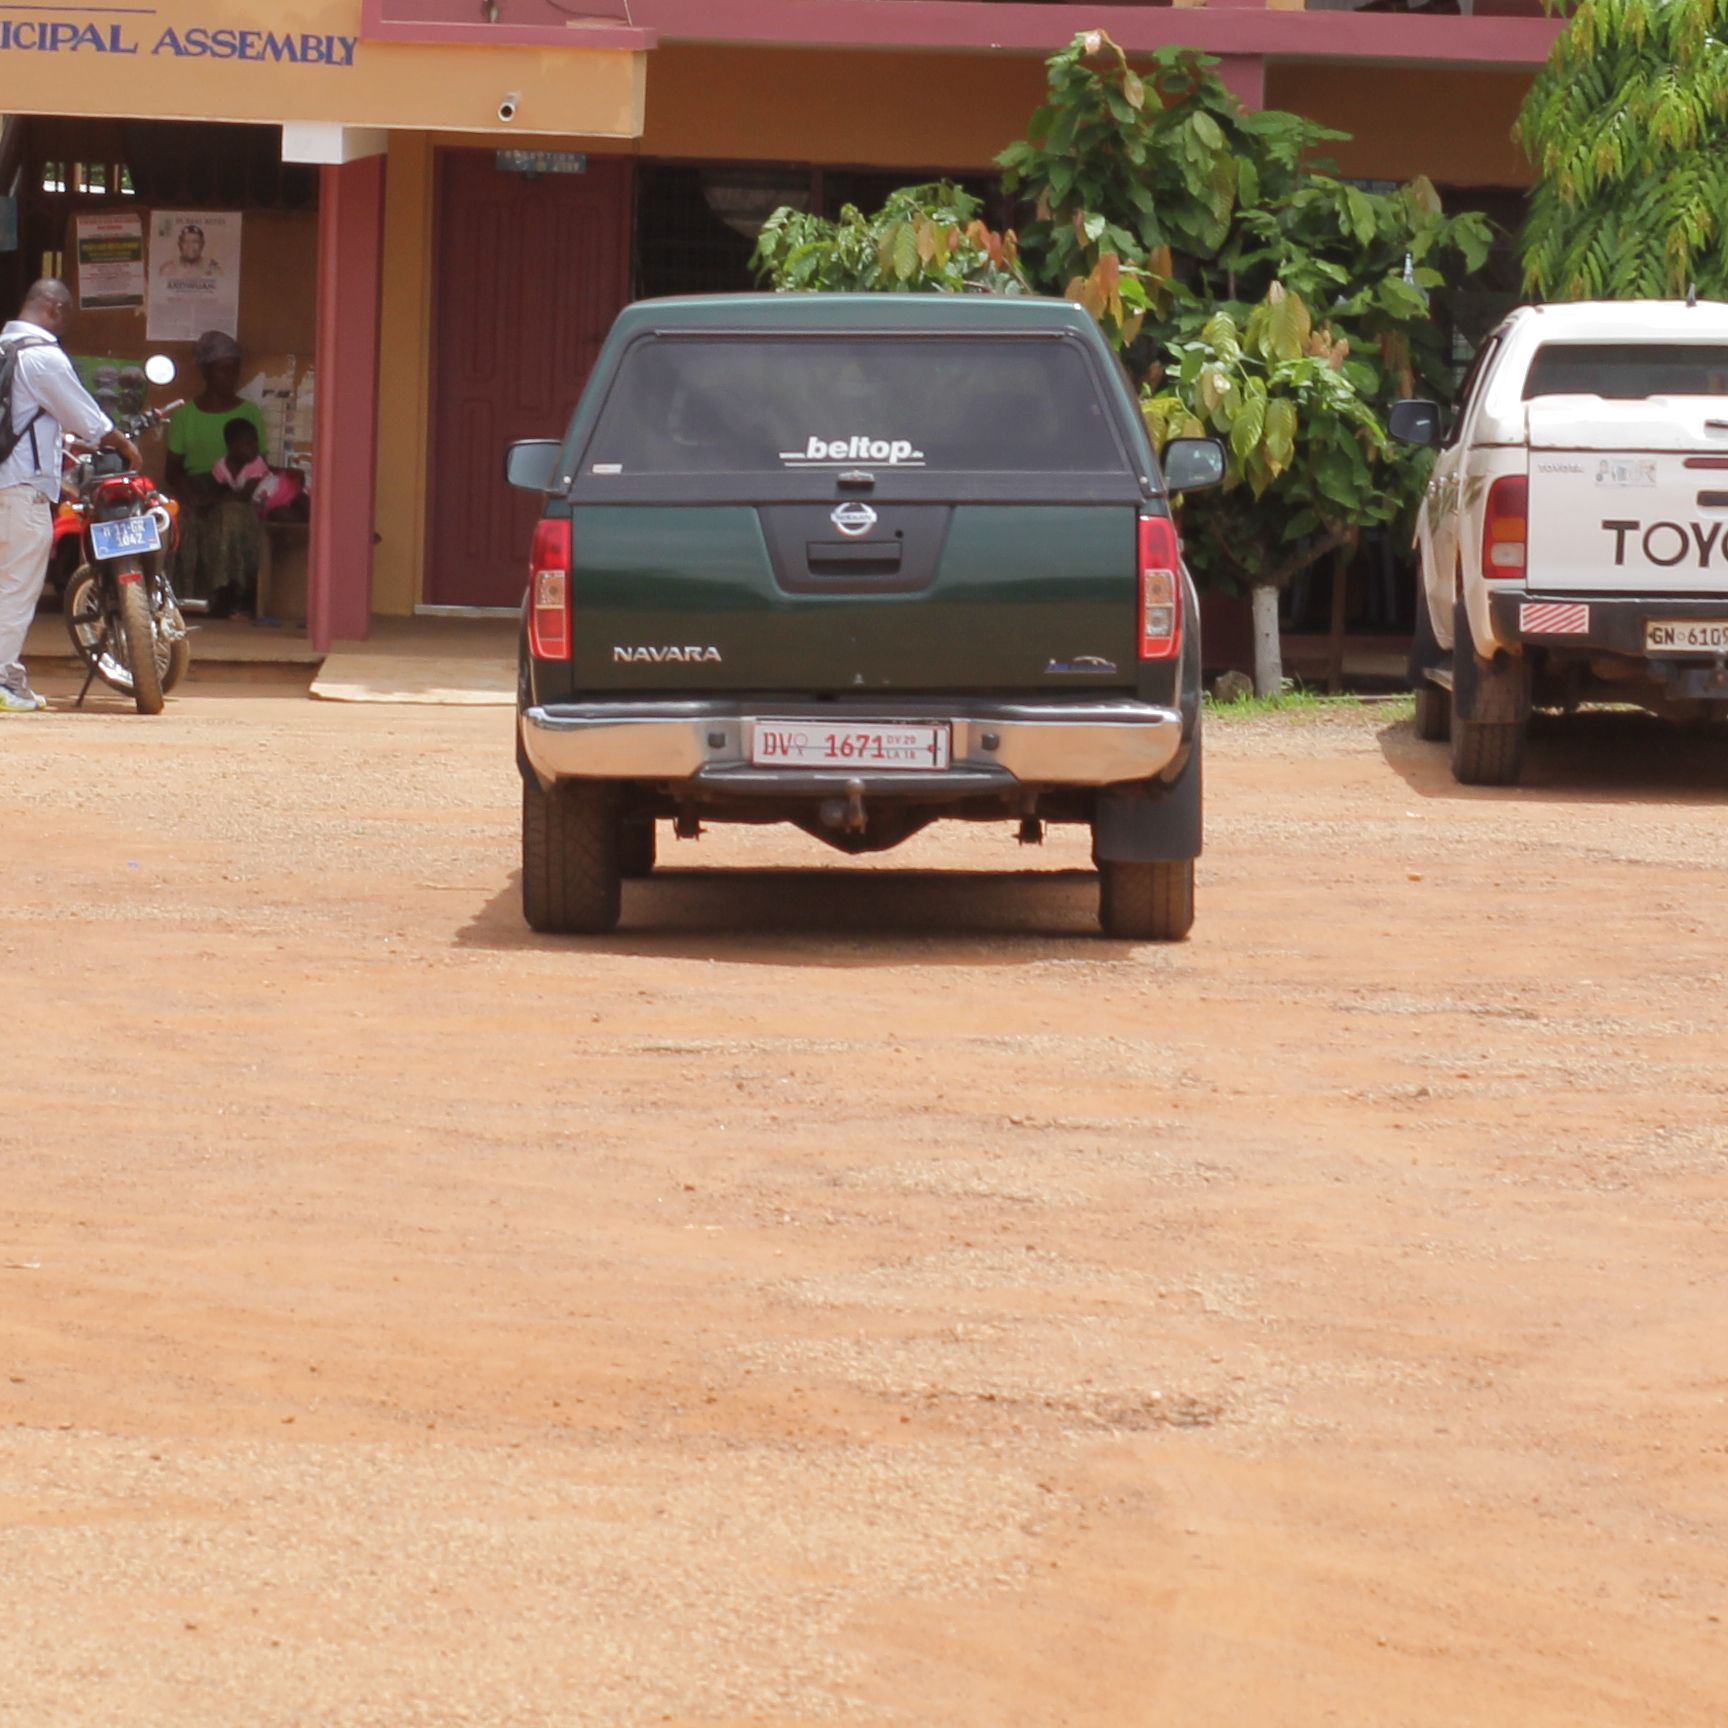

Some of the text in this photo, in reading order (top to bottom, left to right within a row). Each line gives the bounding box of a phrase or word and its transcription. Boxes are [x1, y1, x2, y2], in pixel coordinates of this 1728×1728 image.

[152, 27, 358, 66] ASSEMBLY
[806, 435, 913, 465] beltop
[1651, 626, 1675, 645] GN
[613, 645, 722, 663] NAVARA
[763, 731, 885, 760] DV 1671
